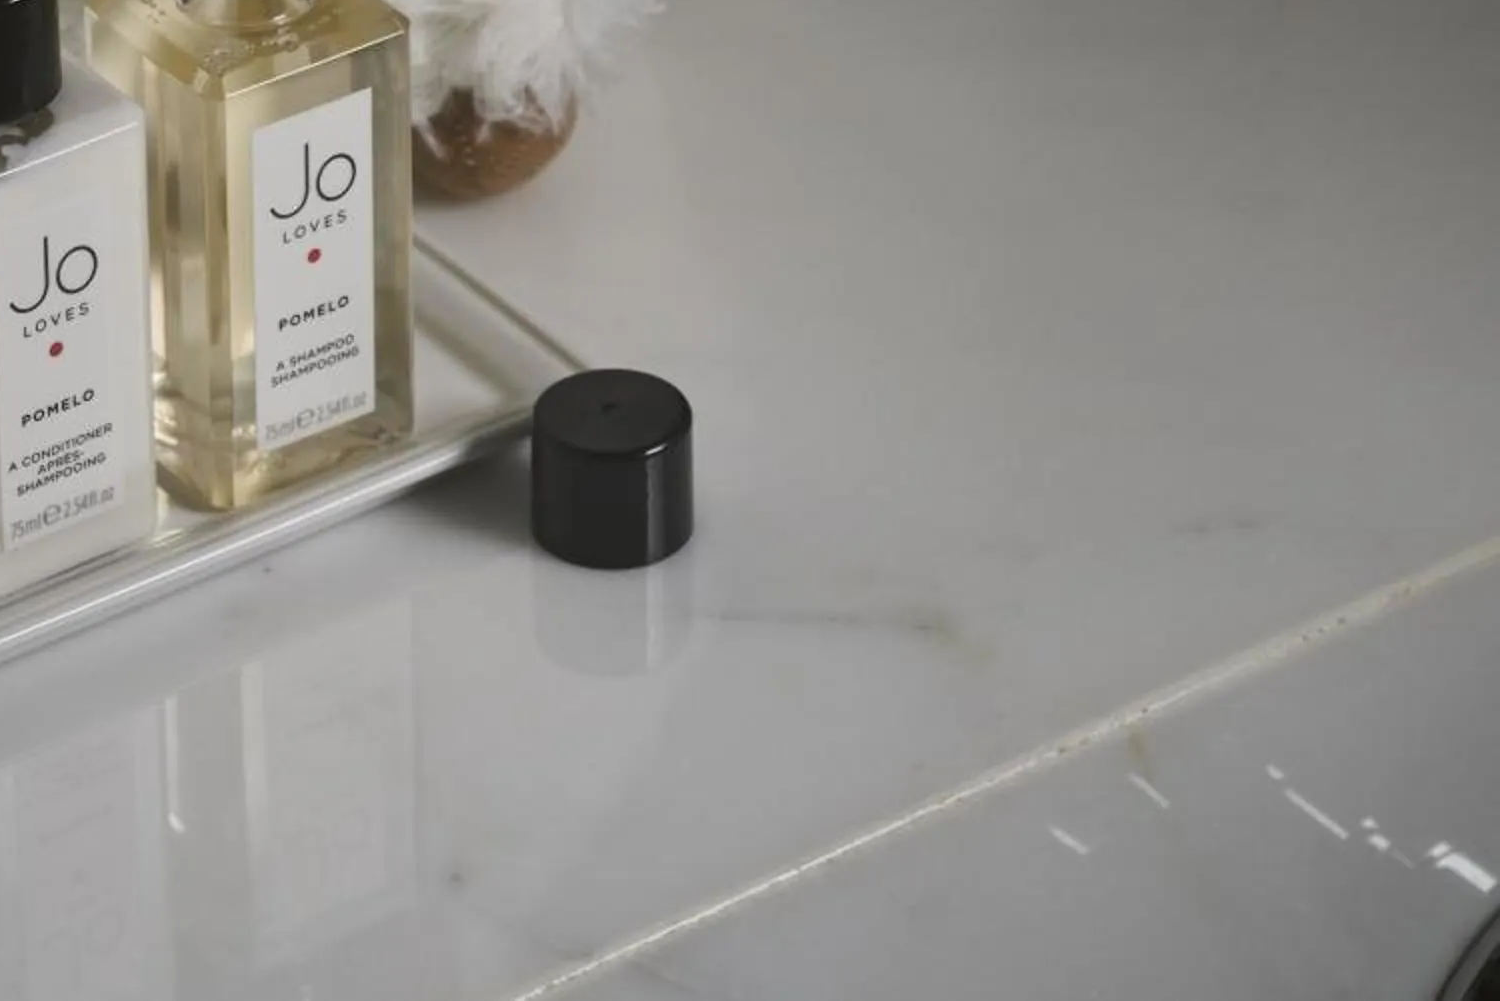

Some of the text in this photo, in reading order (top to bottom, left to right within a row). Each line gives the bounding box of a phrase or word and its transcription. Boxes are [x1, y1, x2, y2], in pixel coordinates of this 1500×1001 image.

[270, 142, 357, 220] Jo
[282, 209, 348, 244] LOVES
[10, 236, 98, 314] Jo
[23, 302, 90, 339] LOVES
[278, 295, 350, 332] POMELO
[270, 343, 360, 388] SHAMPOOING
[275, 333, 355, 372] A SHAMPOO
[21, 388, 95, 428] POMELO
[8, 422, 113, 474] A CONDITIONER
[16, 451, 107, 497] SHAMPOOING
